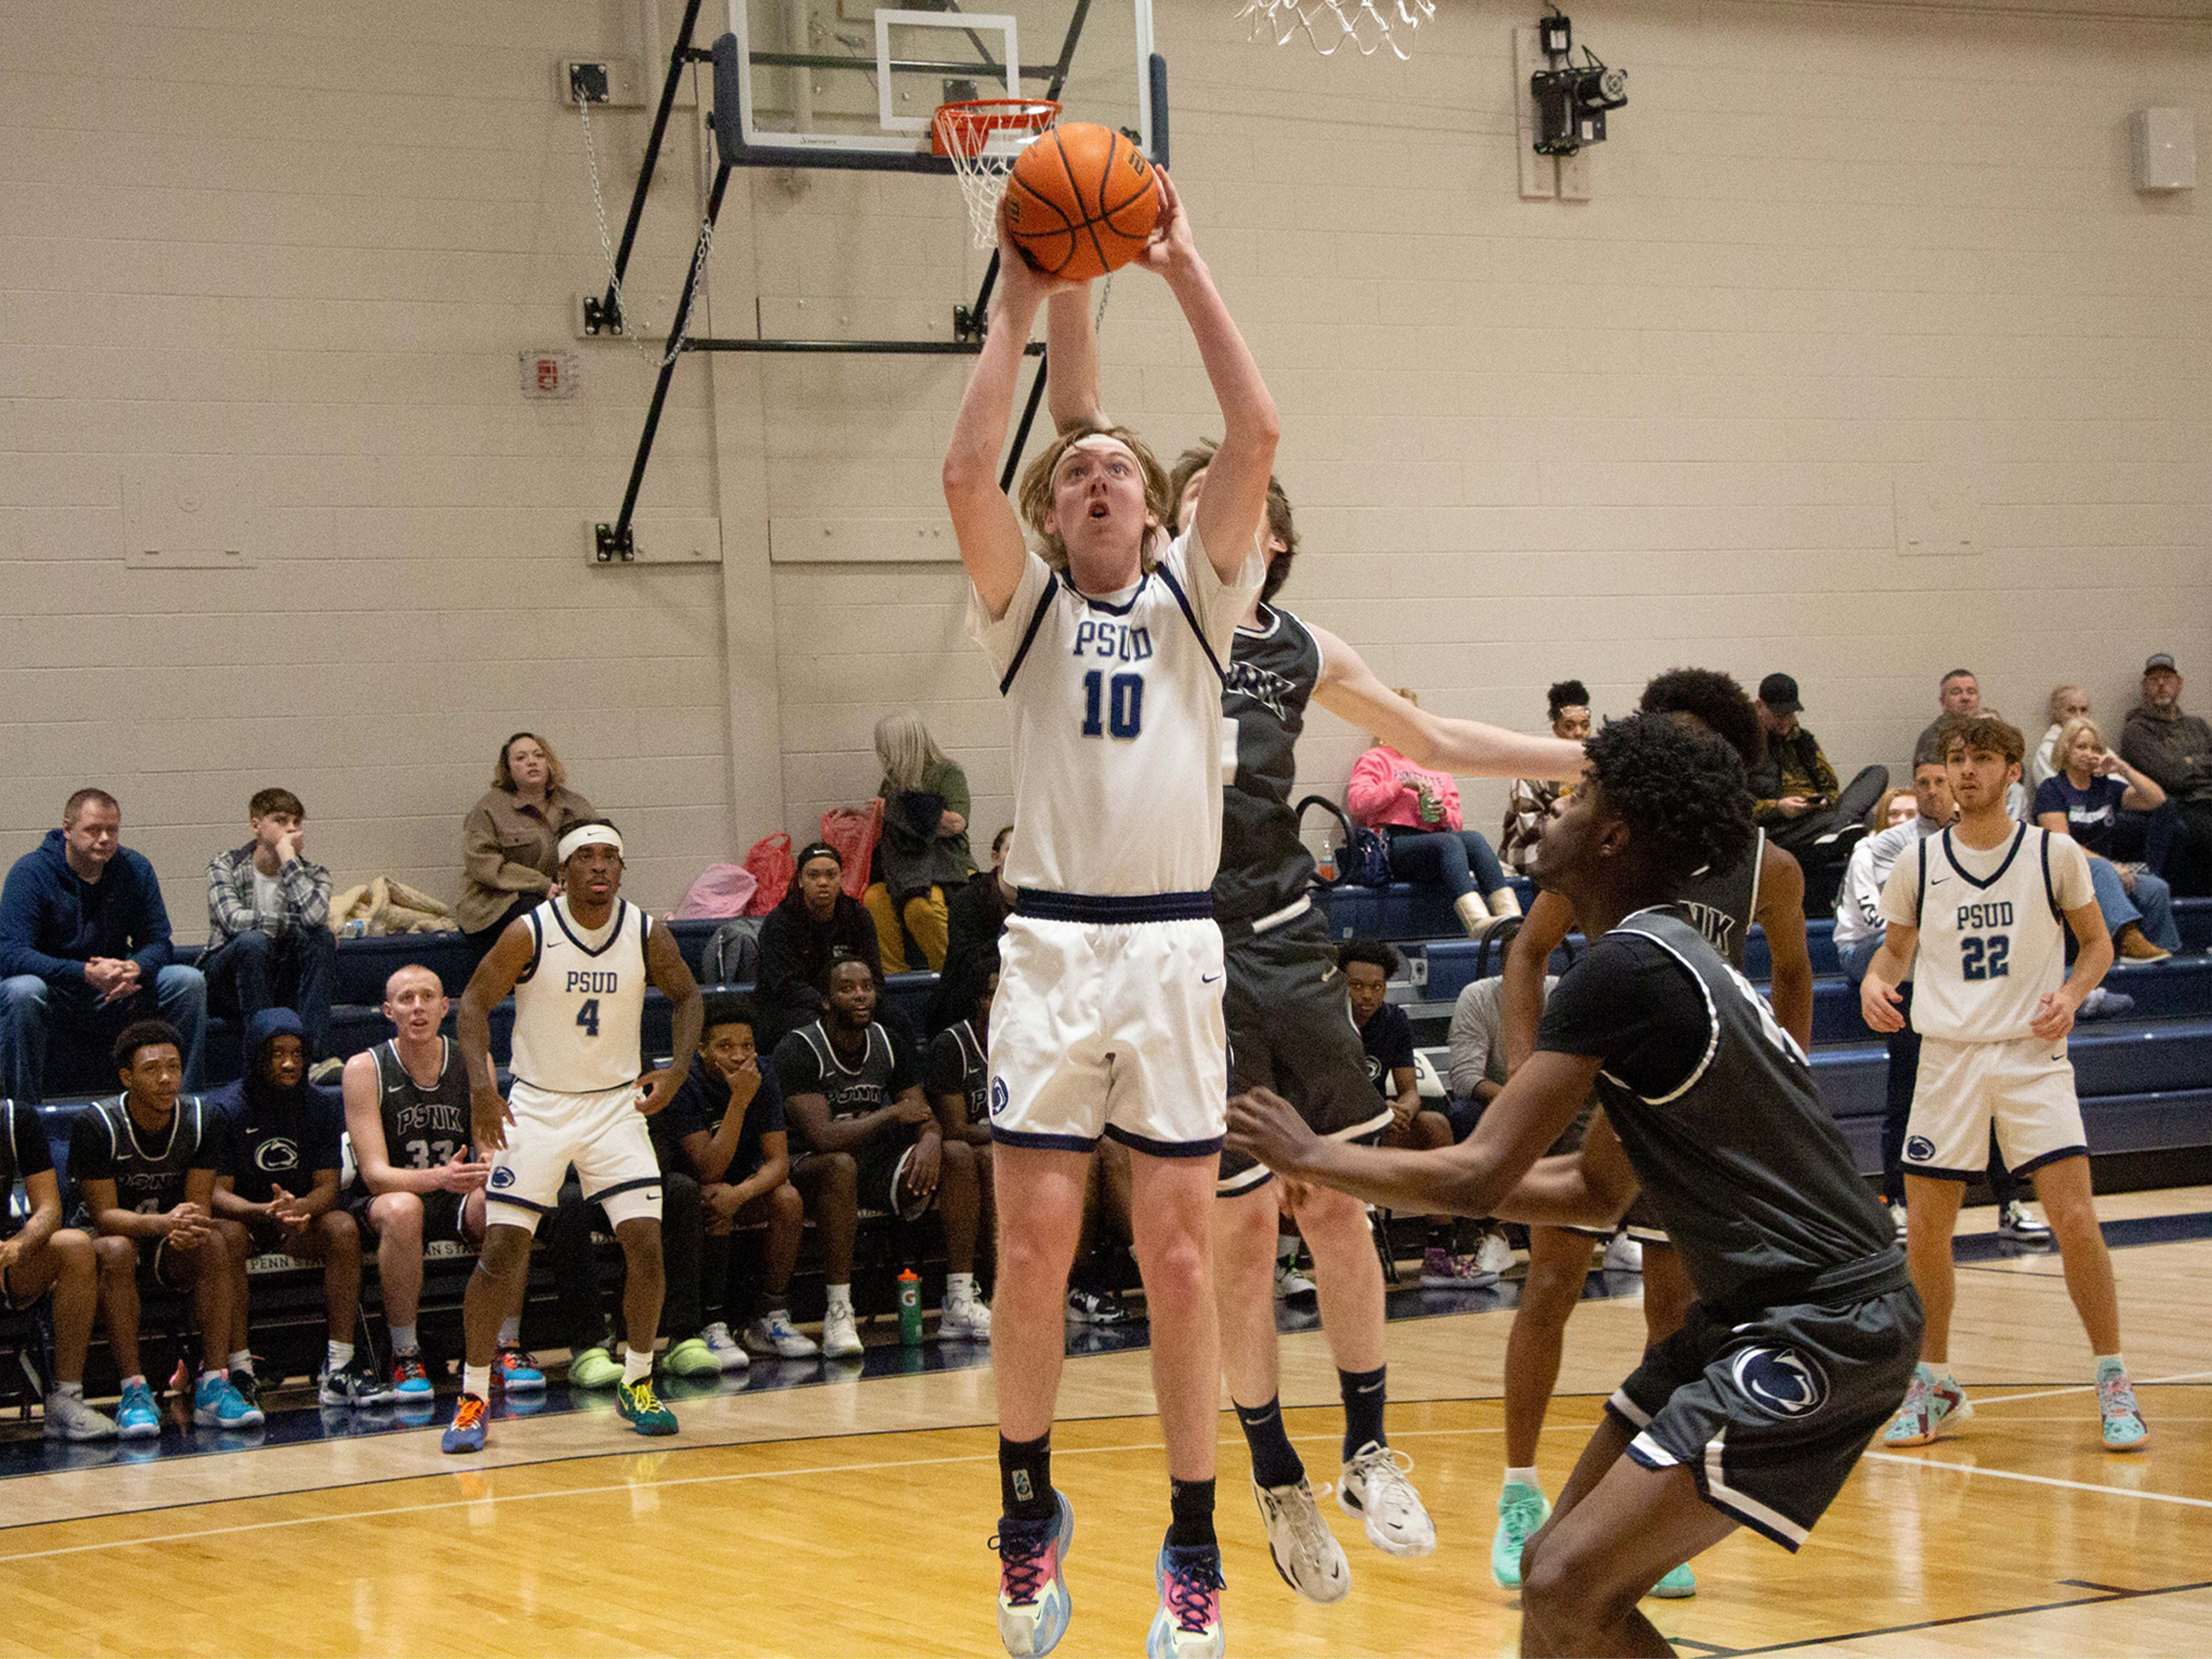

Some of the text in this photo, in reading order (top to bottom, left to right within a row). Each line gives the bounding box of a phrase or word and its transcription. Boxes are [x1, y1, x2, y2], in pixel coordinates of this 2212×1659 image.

[1072, 620, 1153, 663] PSUD
[1081, 669, 1145, 740] 10
[1957, 900, 2014, 931] PSUD
[1960, 934, 2010, 982] 22
[565, 971, 618, 994] PSUD
[576, 998, 600, 1037] 4
[396, 1102, 464, 1136] PSNK
[901, 1289, 917, 1308] G
